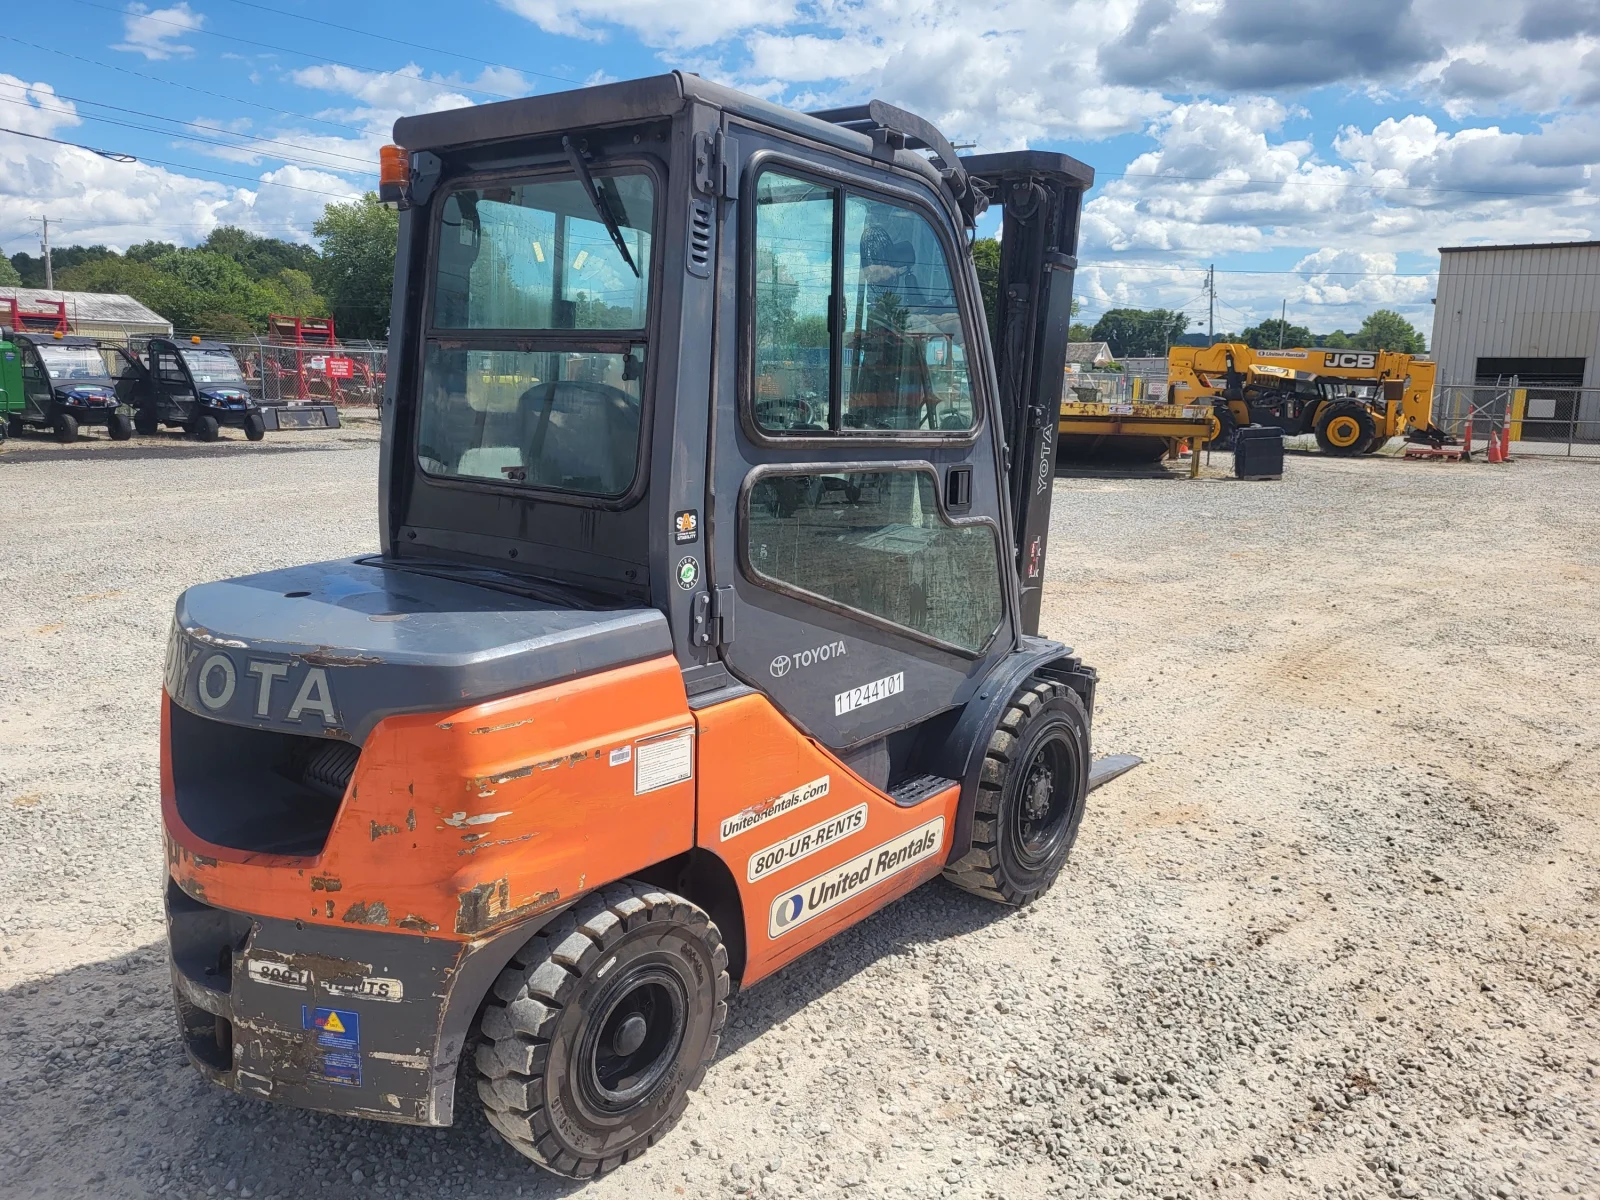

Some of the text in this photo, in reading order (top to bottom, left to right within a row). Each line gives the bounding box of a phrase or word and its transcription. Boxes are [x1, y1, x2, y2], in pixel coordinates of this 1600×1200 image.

[1325, 353, 1376, 368] JCB
[676, 513, 697, 531] SAS
[792, 640, 847, 669] TOYOTA
[836, 673, 902, 714] 11244101
[754, 810, 863, 875] 800-UR-RENTS
[808, 829, 936, 911] United Rentals
